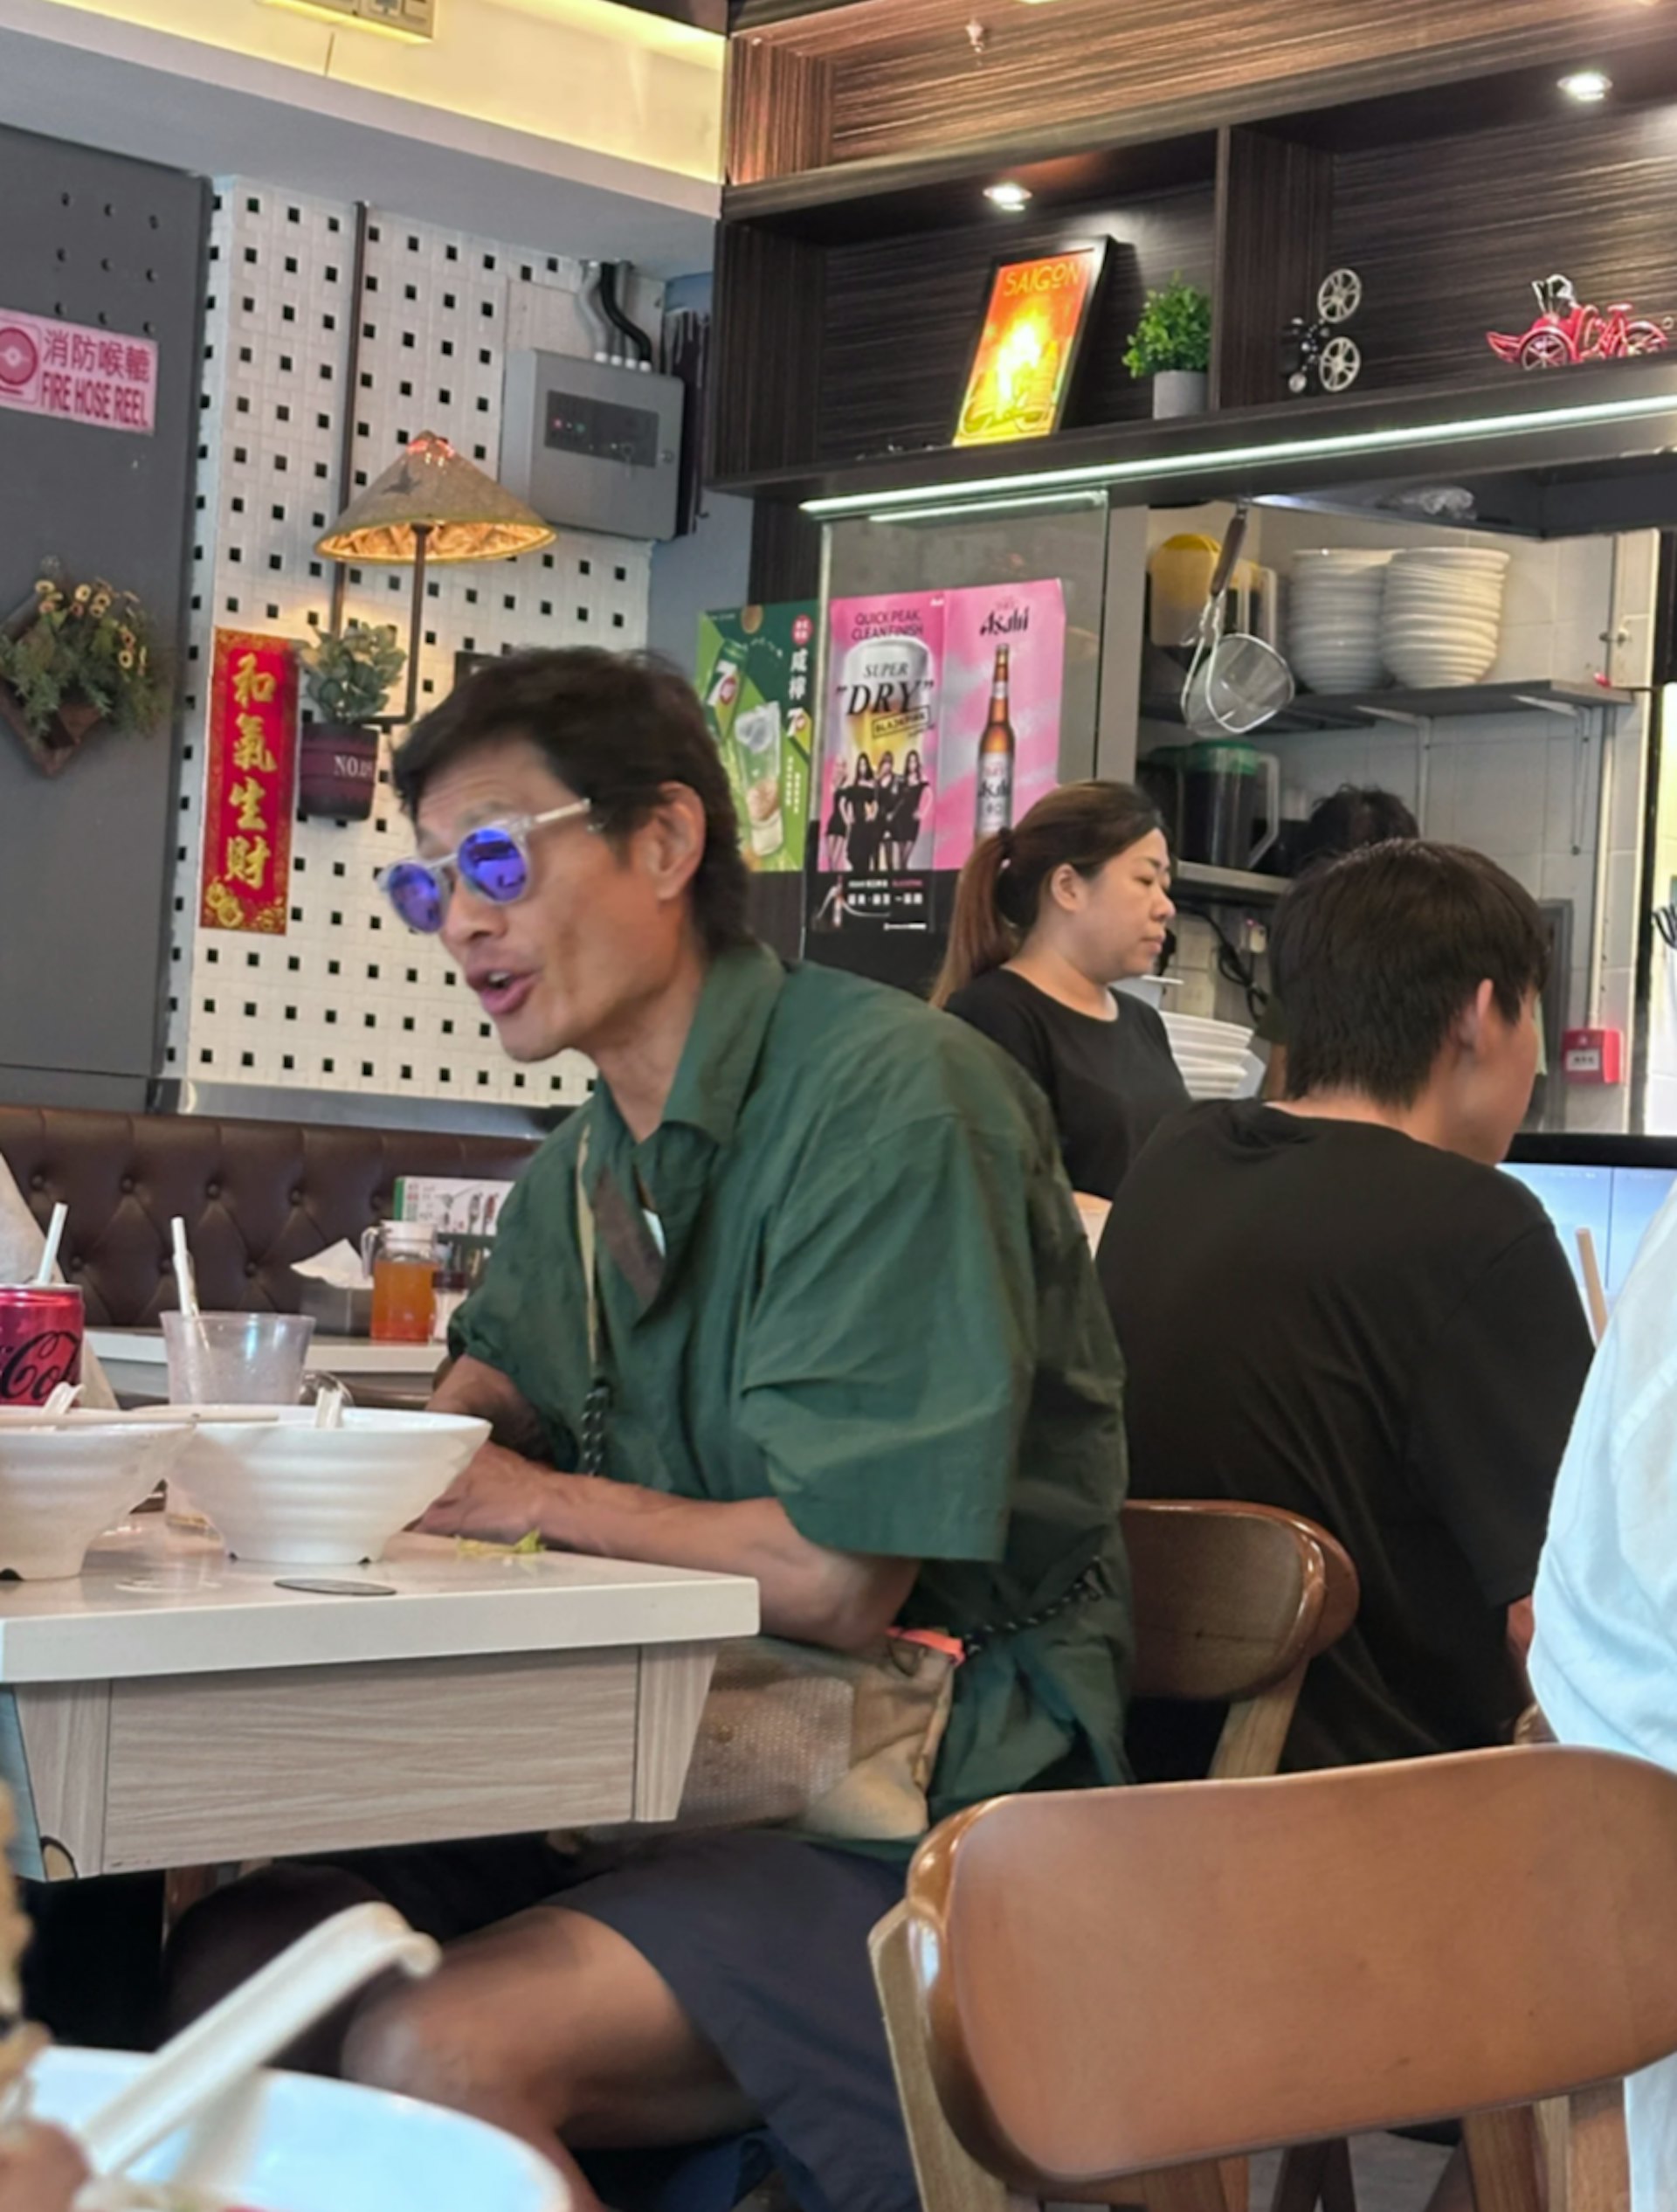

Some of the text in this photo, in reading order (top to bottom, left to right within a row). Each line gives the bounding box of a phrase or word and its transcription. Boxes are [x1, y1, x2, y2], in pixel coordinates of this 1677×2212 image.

[1003, 263, 1080, 297] SAIGON
[41, 371, 148, 427] FIRE HOSE REEL
[854, 611, 889, 626] QUICK
[979, 606, 1029, 636] Asahi
[863, 661, 909, 680] SUPER
[224, 652, 278, 890] 和氣生財
